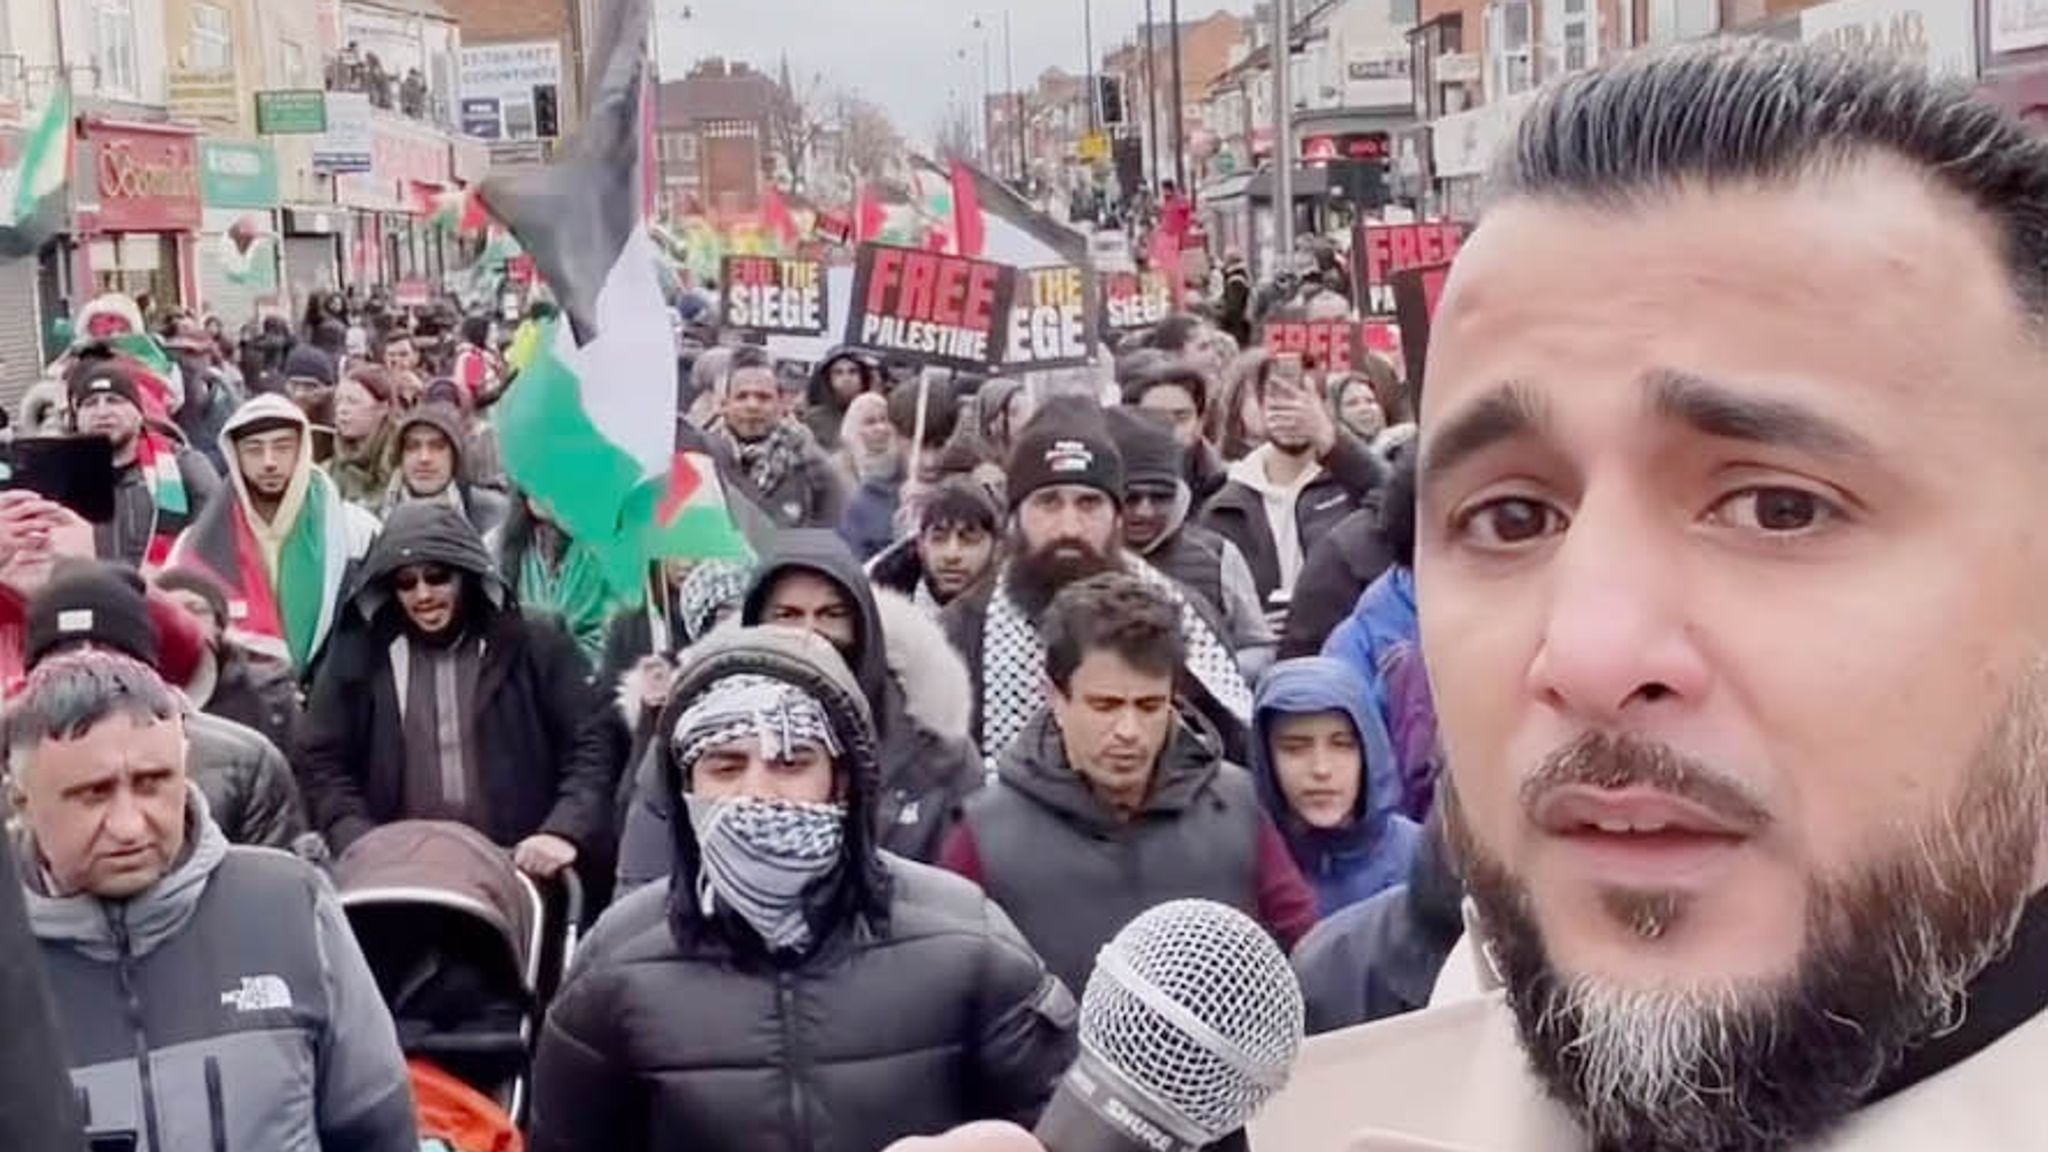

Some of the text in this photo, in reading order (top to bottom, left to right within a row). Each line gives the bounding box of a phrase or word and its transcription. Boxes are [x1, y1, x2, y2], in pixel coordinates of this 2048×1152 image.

[782, 260, 819, 289] THE
[1366, 225, 1461, 285] FREE
[728, 285, 821, 329] SIEGE
[866, 248, 999, 331] FREE
[1028, 266, 1083, 306] THE
[860, 312, 989, 362] PALESTINE
[1002, 304, 1087, 363] EGE
[1102, 1098, 1174, 1152] SHURE
